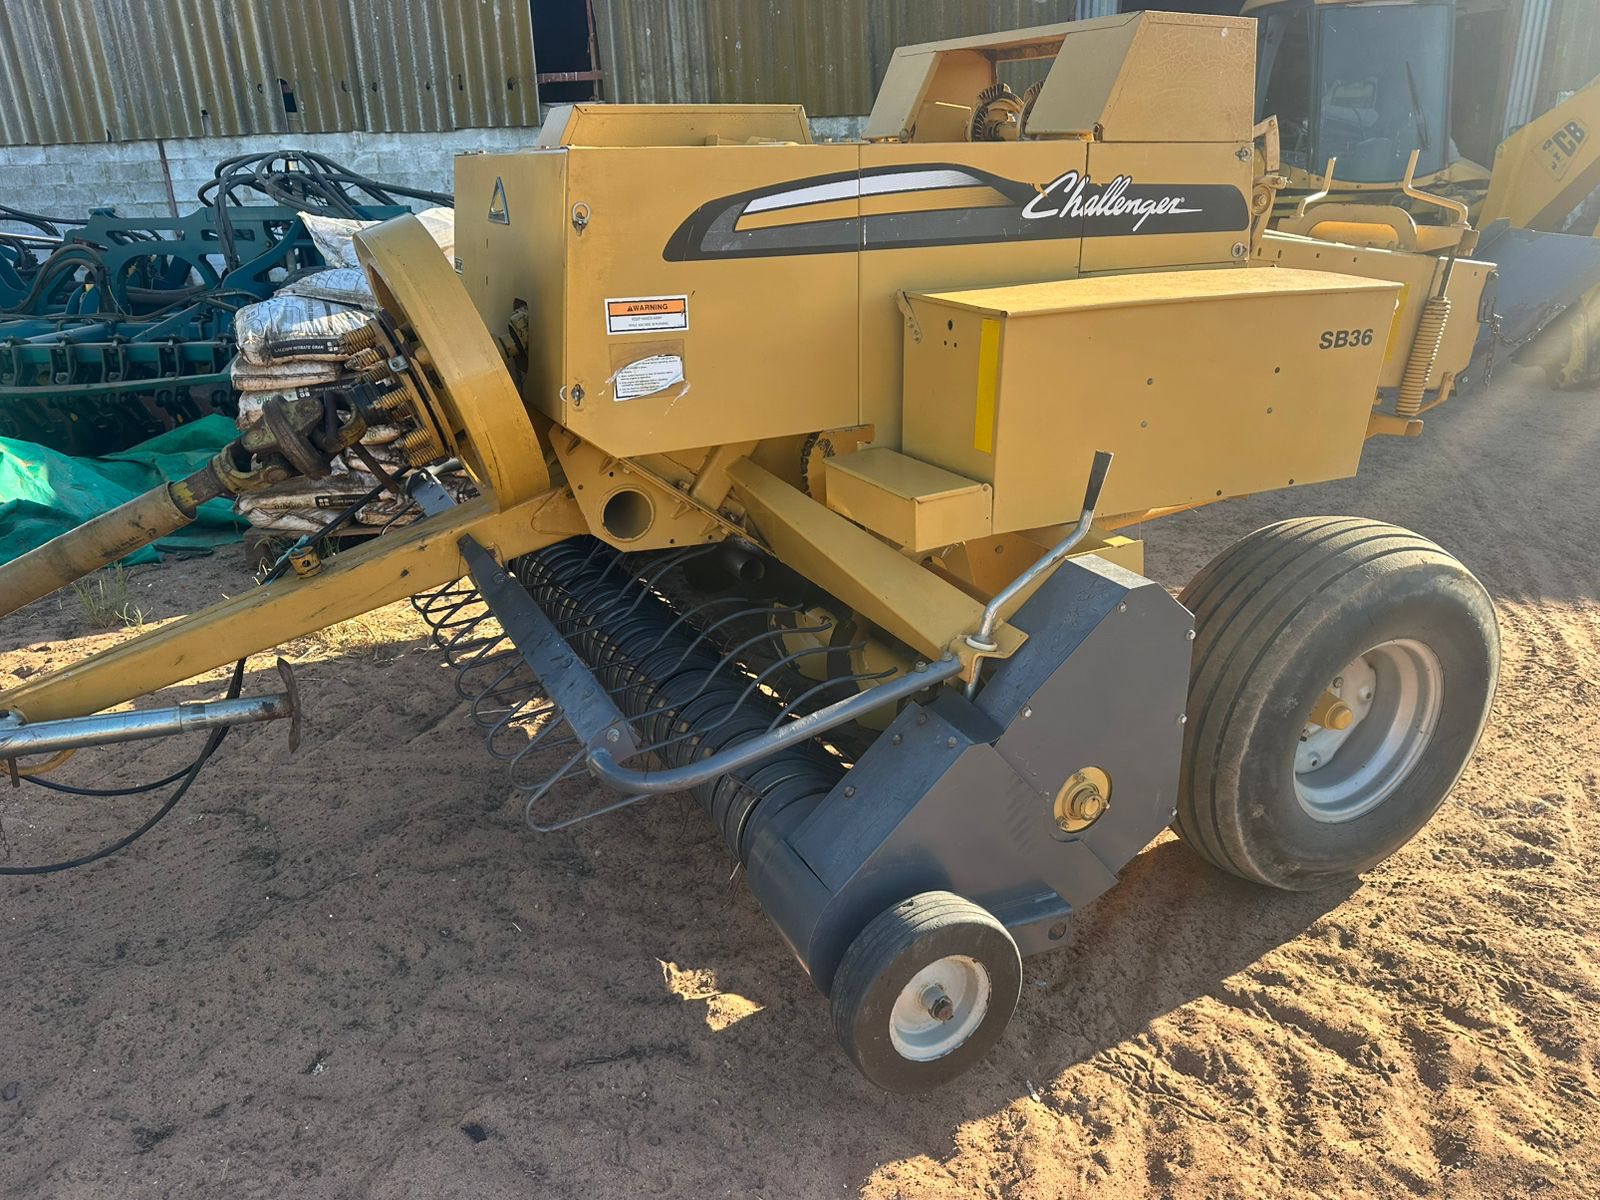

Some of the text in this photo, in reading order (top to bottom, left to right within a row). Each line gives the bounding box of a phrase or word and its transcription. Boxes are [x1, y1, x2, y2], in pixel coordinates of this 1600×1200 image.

[1022, 170, 1203, 232] Challenger
[633, 304, 668, 312] WARNING
[1319, 328, 1373, 349] SB36
